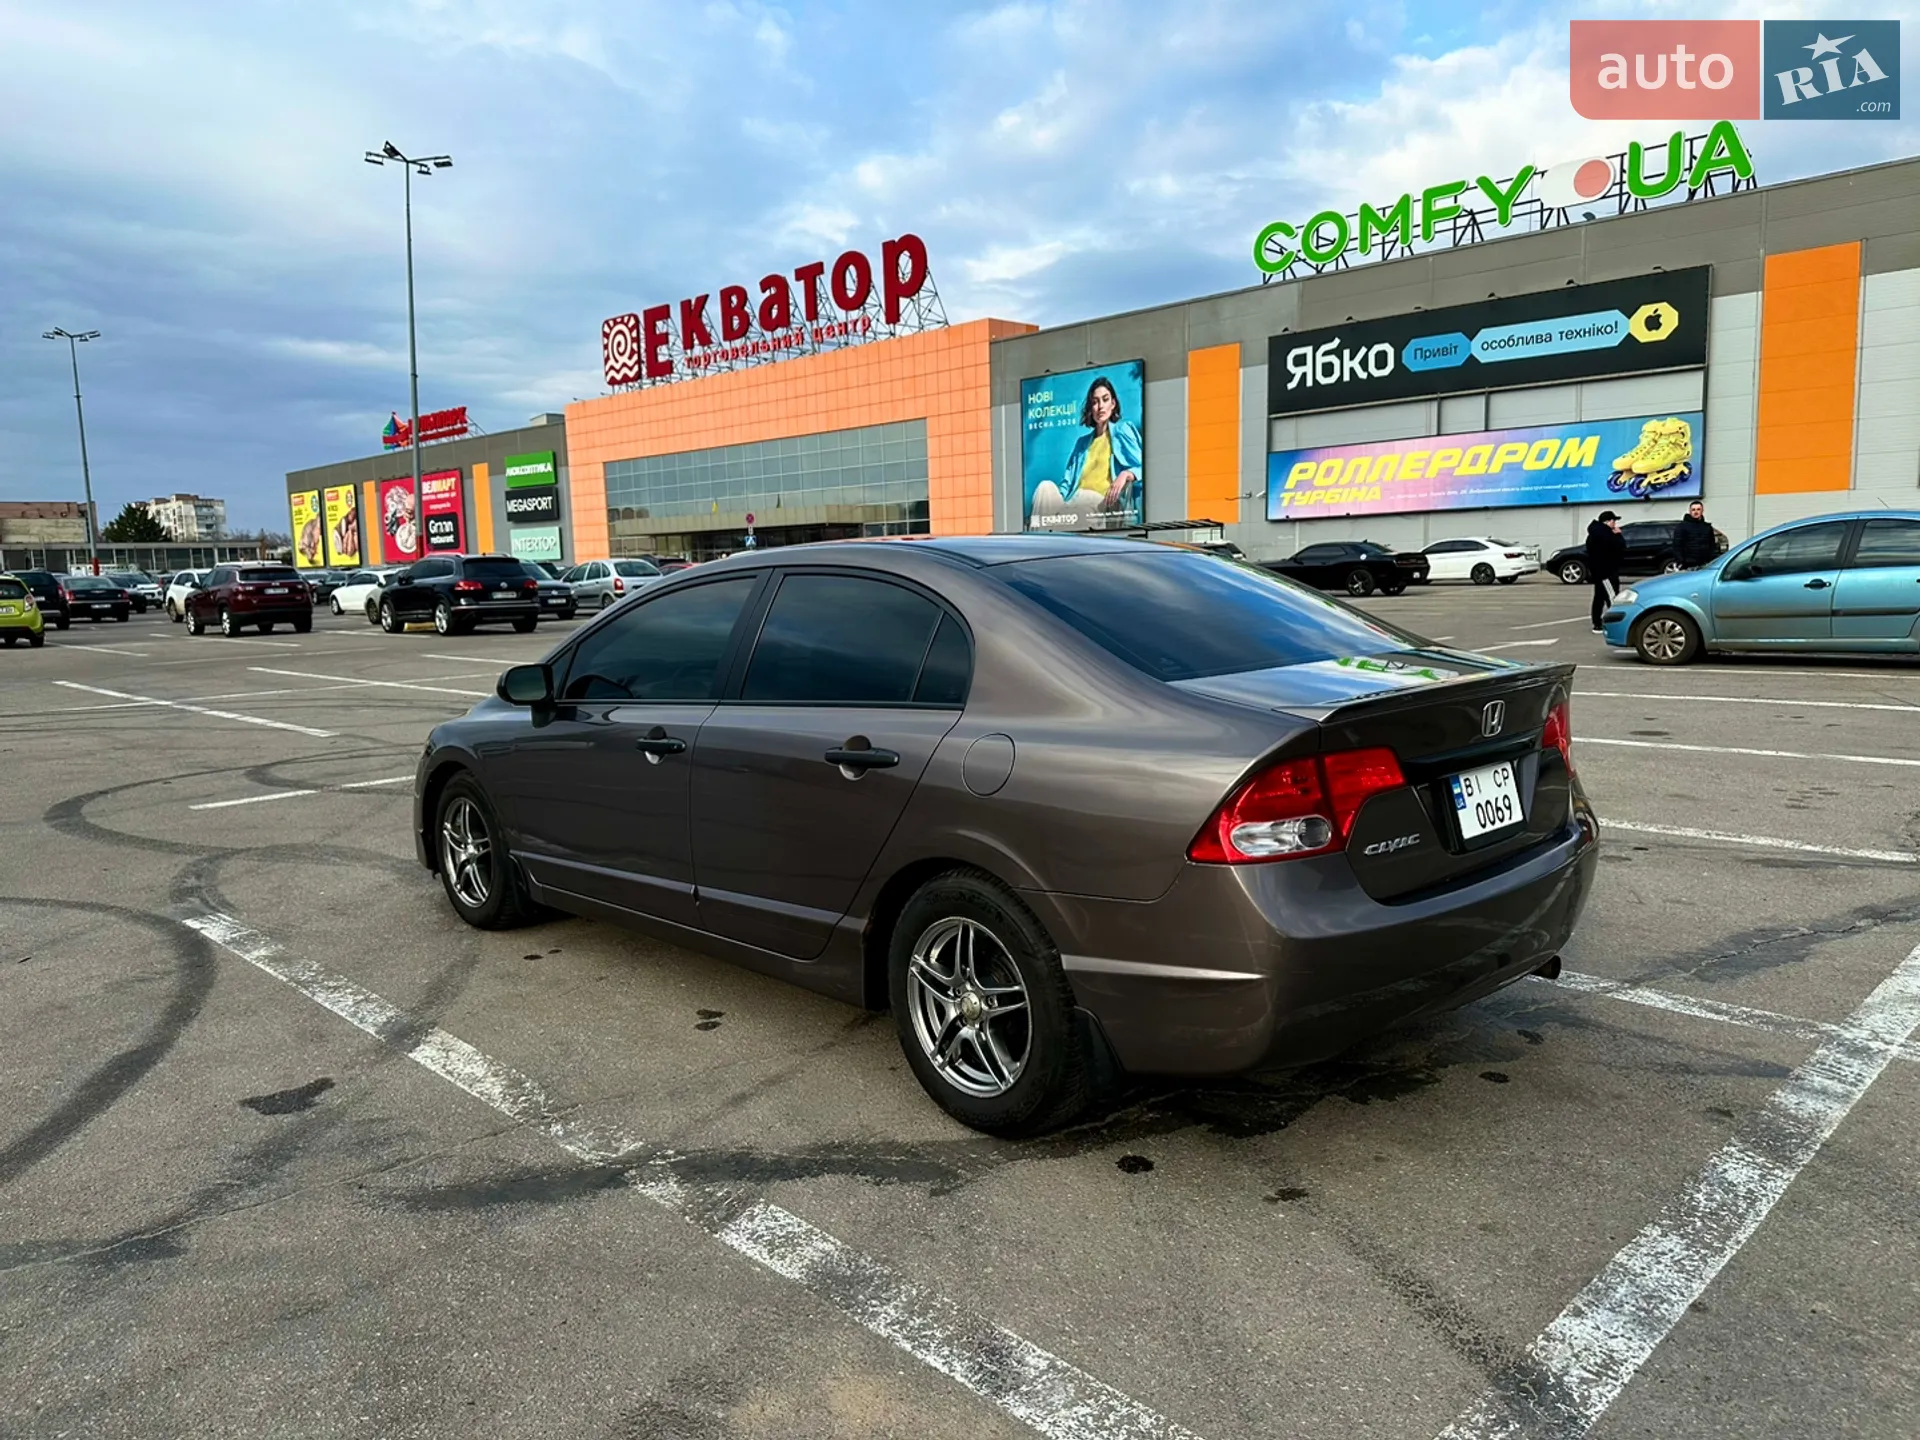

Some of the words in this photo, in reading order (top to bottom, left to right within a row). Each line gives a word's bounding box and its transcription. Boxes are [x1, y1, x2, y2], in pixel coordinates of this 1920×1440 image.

[1253, 164, 1537, 274] COMFY
[1627, 119, 1756, 200] UA
[642, 233, 928, 380] Екватор
[684, 327, 804, 369] торговельний
[811, 314, 872, 344] центр
[1413, 343, 1458, 363] Привіт
[1480, 330, 1553, 352] особлива
[1558, 321, 1619, 342] техніко!
[1286, 337, 1395, 391] Ябко
[1028, 391, 1053, 404] НОВІ
[1028, 401, 1077, 419] КОЛЕКЦІЇ
[1028, 421, 1054, 430] ВЕСНА
[1284, 434, 1601, 490] РОЛЛЕРДРОМ
[506, 496, 553, 512] MEGASPORT
[1279, 484, 1382, 507] ТУРБІНА
[512, 535, 557, 553] INTERTOP
[1463, 774, 1483, 798] BI
[1492, 766, 1510, 788] CP
[1475, 794, 1513, 830] 0069
[1363, 833, 1421, 856] CIVIC
